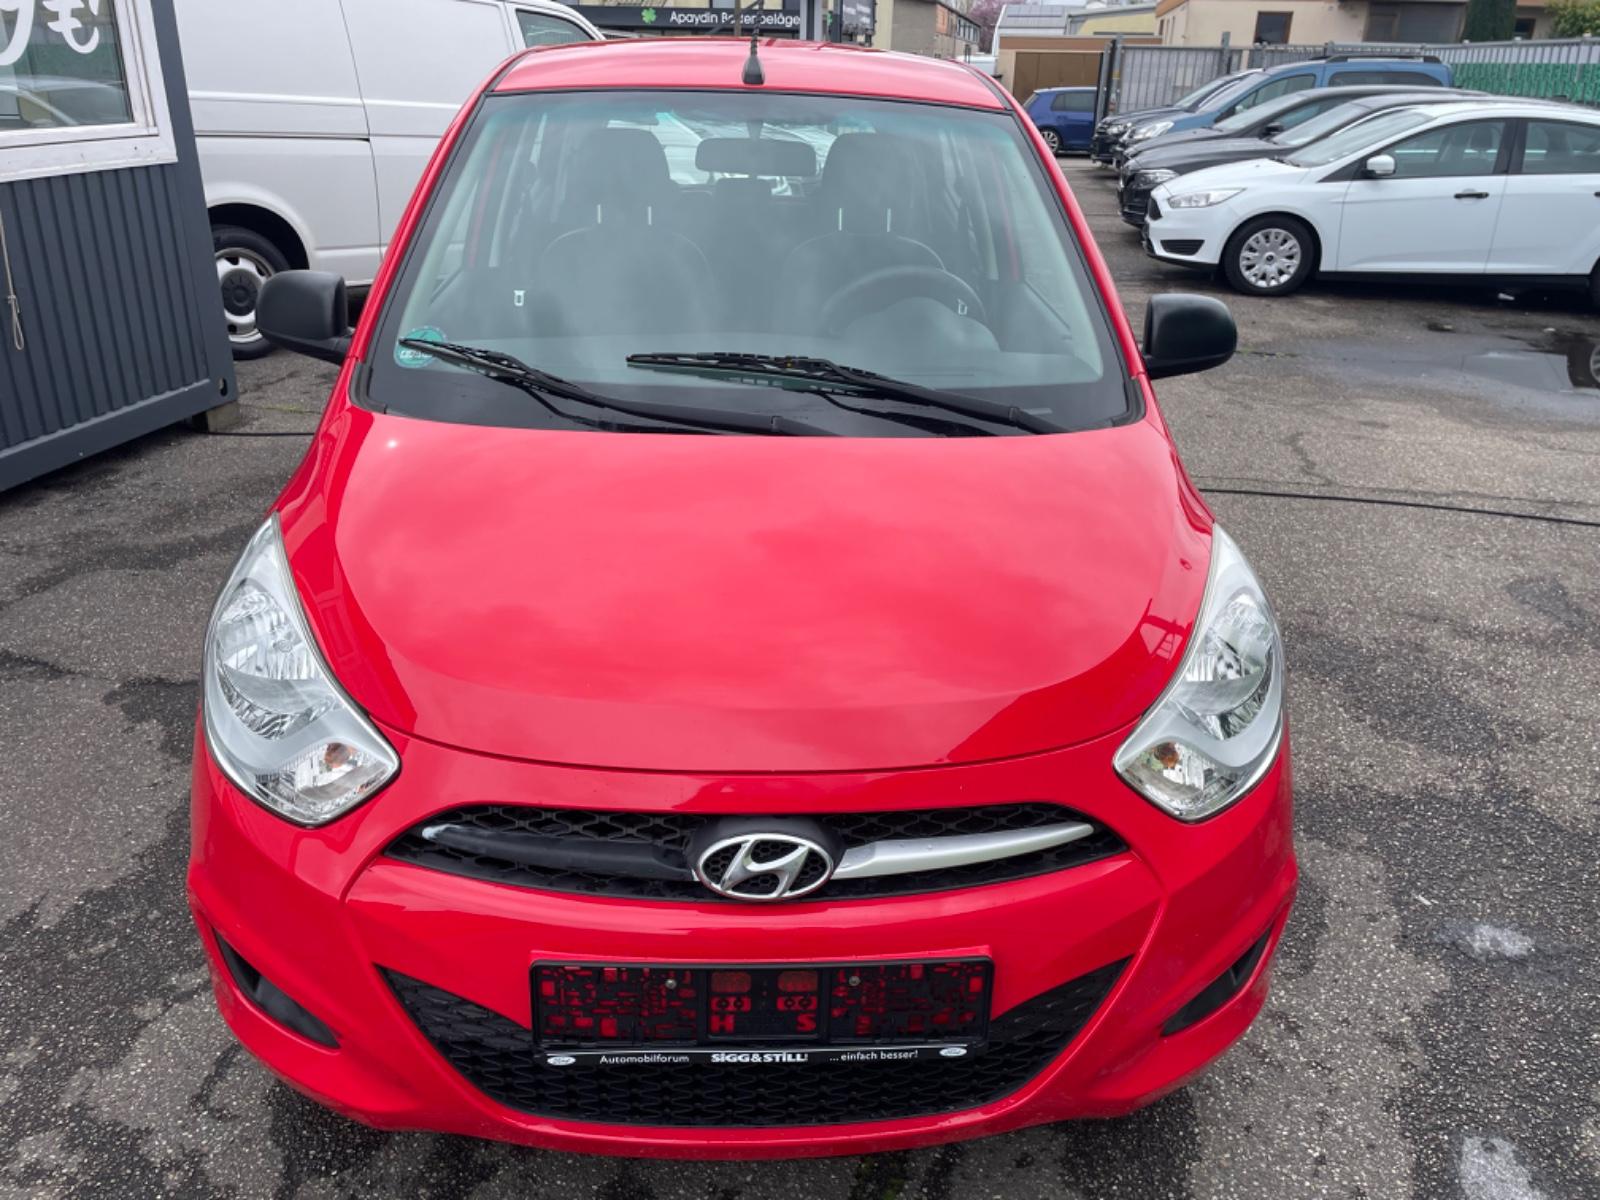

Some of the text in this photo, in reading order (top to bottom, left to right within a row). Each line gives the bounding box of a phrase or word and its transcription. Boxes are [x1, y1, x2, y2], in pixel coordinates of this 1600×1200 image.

[670, 11, 801, 27] Apaydin Boenbeläge
[599, 1054, 690, 1064] Automobilforum
[880, 1050, 919, 1060] besser!
